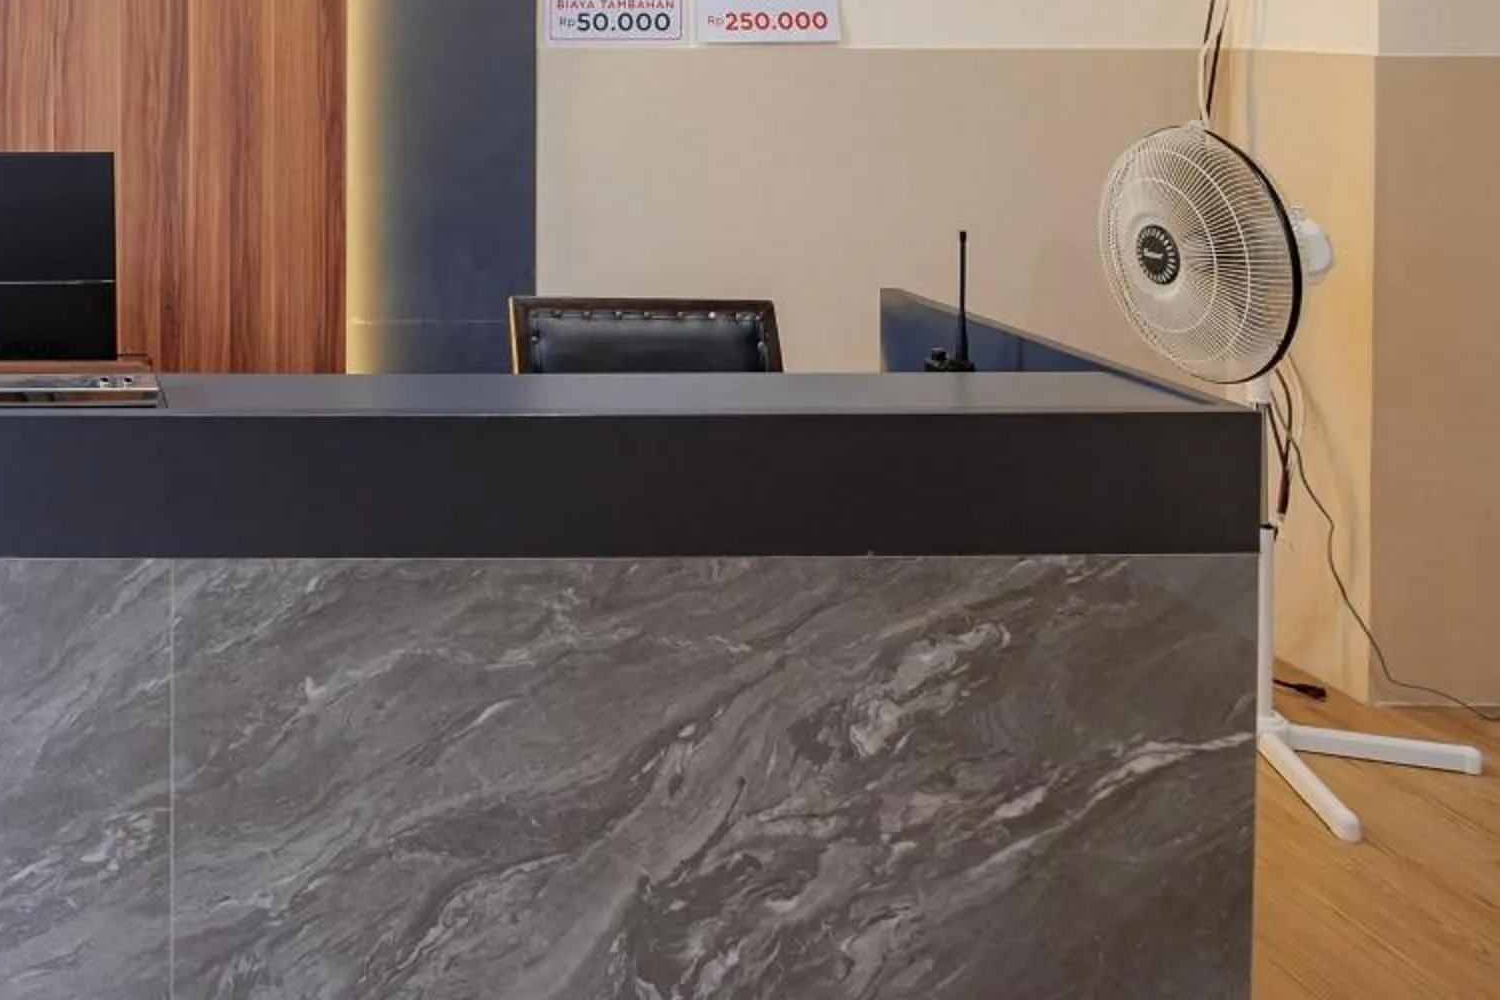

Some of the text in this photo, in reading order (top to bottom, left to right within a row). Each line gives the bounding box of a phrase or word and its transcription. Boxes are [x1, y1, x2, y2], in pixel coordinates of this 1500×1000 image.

[557, 0, 674, 9] BIAYA TAMBAHAN
[559, 13, 671, 31] Rp 50.000
[707, 12, 827, 30] Rp 250.000
